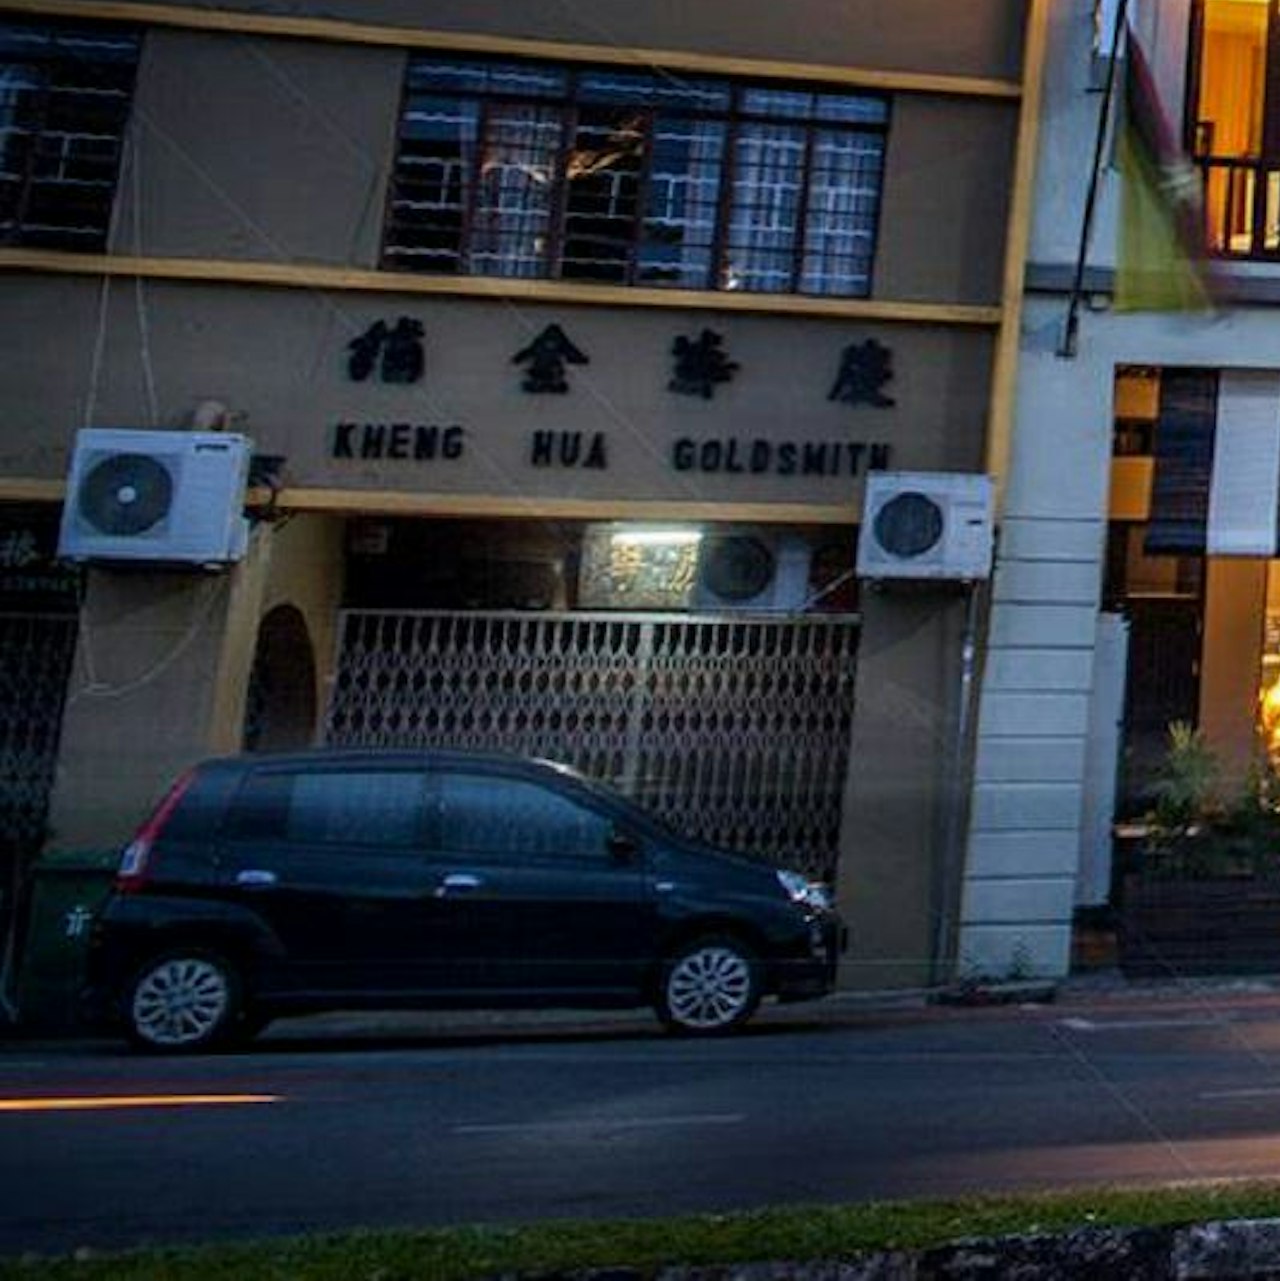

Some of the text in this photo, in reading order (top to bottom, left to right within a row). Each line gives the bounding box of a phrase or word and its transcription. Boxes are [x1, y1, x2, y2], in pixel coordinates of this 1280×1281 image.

[333, 422, 890, 476] KHENG HUA GOLDSMITH
